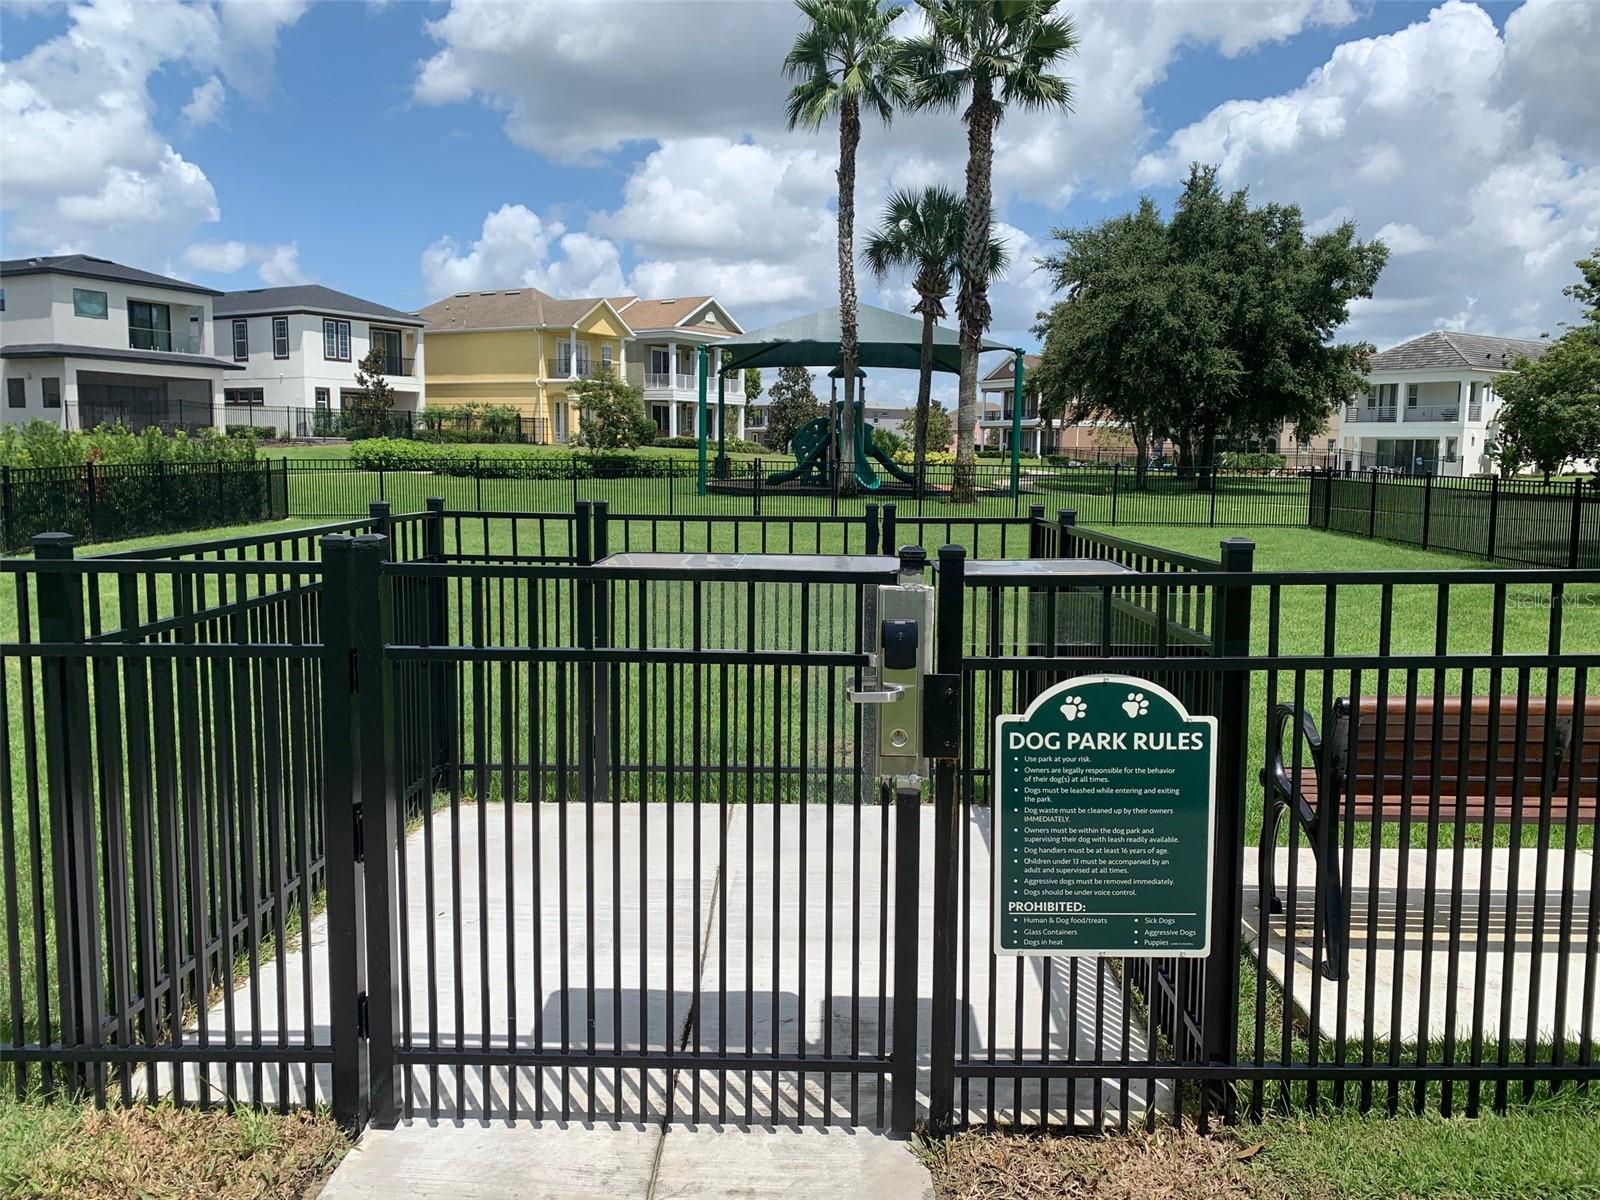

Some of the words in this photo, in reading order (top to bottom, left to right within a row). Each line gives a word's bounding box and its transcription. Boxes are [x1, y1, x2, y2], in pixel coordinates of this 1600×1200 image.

[1009, 732, 1060, 750] DOG
[1067, 732, 1127, 750] PARK
[1133, 732, 1205, 751] RULES
[1024, 755, 1037, 763] Use
[1038, 755, 1053, 764] park
[1054, 755, 1061, 763] at
[1062, 756, 1077, 764] your
[1078, 755, 1092, 763] risk.
[1024, 766, 1050, 774] Owners
[1062, 766, 1084, 776] legally
[1085, 767, 1123, 775] responsible
[1124, 766, 1134, 774] for
[1134, 767, 1146, 775] the
[1147, 767, 1176, 775] behavior
[1024, 775, 1032, 783] of
[1032, 775, 1048, 783] their
[1049, 775, 1070, 784] dog(s)
[1071, 776, 1079, 784] at
[1079, 776, 1088, 784] all
[1089, 776, 1110, 784] times.
[1024, 786, 1042, 795] Dogs
[1042, 787, 1060, 795] must
[1060, 787, 1069, 795] be
[1070, 787, 1096, 795] leashed
[1096, 787, 1114, 795] while
[1114, 788, 1143, 796] entering
[1143, 787, 1156, 795] and
[1157, 788, 1180, 796] exiting
[1024, 795, 1036, 803] the
[1036, 796, 1053, 804] park.
[1024, 806, 1038, 816] Dog
[1038, 808, 1059, 816] waste
[1059, 807, 1077, 815] must
[1078, 807, 1086, 815] be
[1086, 807, 1113, 815] cleaned
[1113, 808, 1123, 816] up
[1123, 808, 1132, 816] by
[1132, 807, 1148, 815] their
[1024, 816, 1070, 824] IMMEDIATELY.
[1024, 826, 1050, 834] Owners
[1050, 827, 1068, 835] must
[1068, 827, 1077, 835] be
[1078, 827, 1099, 835] within
[1100, 827, 1112, 835] the
[1112, 827, 1125, 836] dog
[1126, 827, 1140, 835] park
[1142, 827, 1154, 835] and
[1024, 836, 1061, 844] supervising
[1061, 835, 1077, 843] their
[1078, 836, 1091, 844] dog
[1091, 836, 1106, 844] with
[1107, 836, 1125, 844] leash
[1126, 836, 1148, 844] readily
[1149, 836, 1181, 844] available.
[1024, 846, 1038, 855] Dog
[1038, 847, 1067, 855] handlers
[1068, 847, 1085, 855] must
[1086, 847, 1094, 855] be
[1095, 847, 1102, 855] at
[1104, 847, 1120, 855] least
[1120, 847, 1128, 855] 16
[1129, 848, 1146, 856] years
[1147, 847, 1155, 855] of
[1156, 848, 1171, 856] age.
[1052, 858, 1072, 866] under
[1072, 858, 1079, 866] 13
[1080, 858, 1098, 866] must
[1098, 858, 1107, 866] be
[1108, 858, 1151, 866] accompanied
[1152, 858, 1160, 866] by
[1024, 866, 1041, 874] adult
[1042, 867, 1055, 875] and
[1056, 867, 1090, 875] supervised
[1091, 867, 1098, 875] at
[1099, 867, 1108, 875] all
[1108, 867, 1129, 875] times.
[1024, 878, 1058, 886] Aggressive
[1059, 878, 1075, 886] dogs
[1076, 878, 1093, 886] must
[1094, 878, 1102, 886] be
[1103, 878, 1132, 886] removed
[1133, 878, 1174, 886] immediately.
[1024, 888, 1041, 897] Dogs
[1041, 888, 1064, 896] should
[1064, 889, 1073, 897] be
[1074, 889, 1093, 897] under
[1094, 889, 1111, 897] voice
[1008, 901, 1086, 912] PROHIBITED:
[1024, 917, 1048, 925] Human
[1048, 917, 1054, 925] &
[1056, 917, 1070, 925] Dog
[1070, 916, 1108, 924] food/treats
[1144, 917, 1158, 925] Sick
[1158, 917, 1176, 925] Dogs
[1024, 928, 1042, 936] Glass
[1042, 928, 1078, 936] Containers
[1144, 929, 1179, 937] Aggressive
[1180, 929, 1196, 937] Dogs
[1023, 938, 1040, 947] Dogs
[1041, 938, 1048, 946] in
[1048, 939, 1063, 947] heat
[1144, 939, 1169, 947] Puppies
